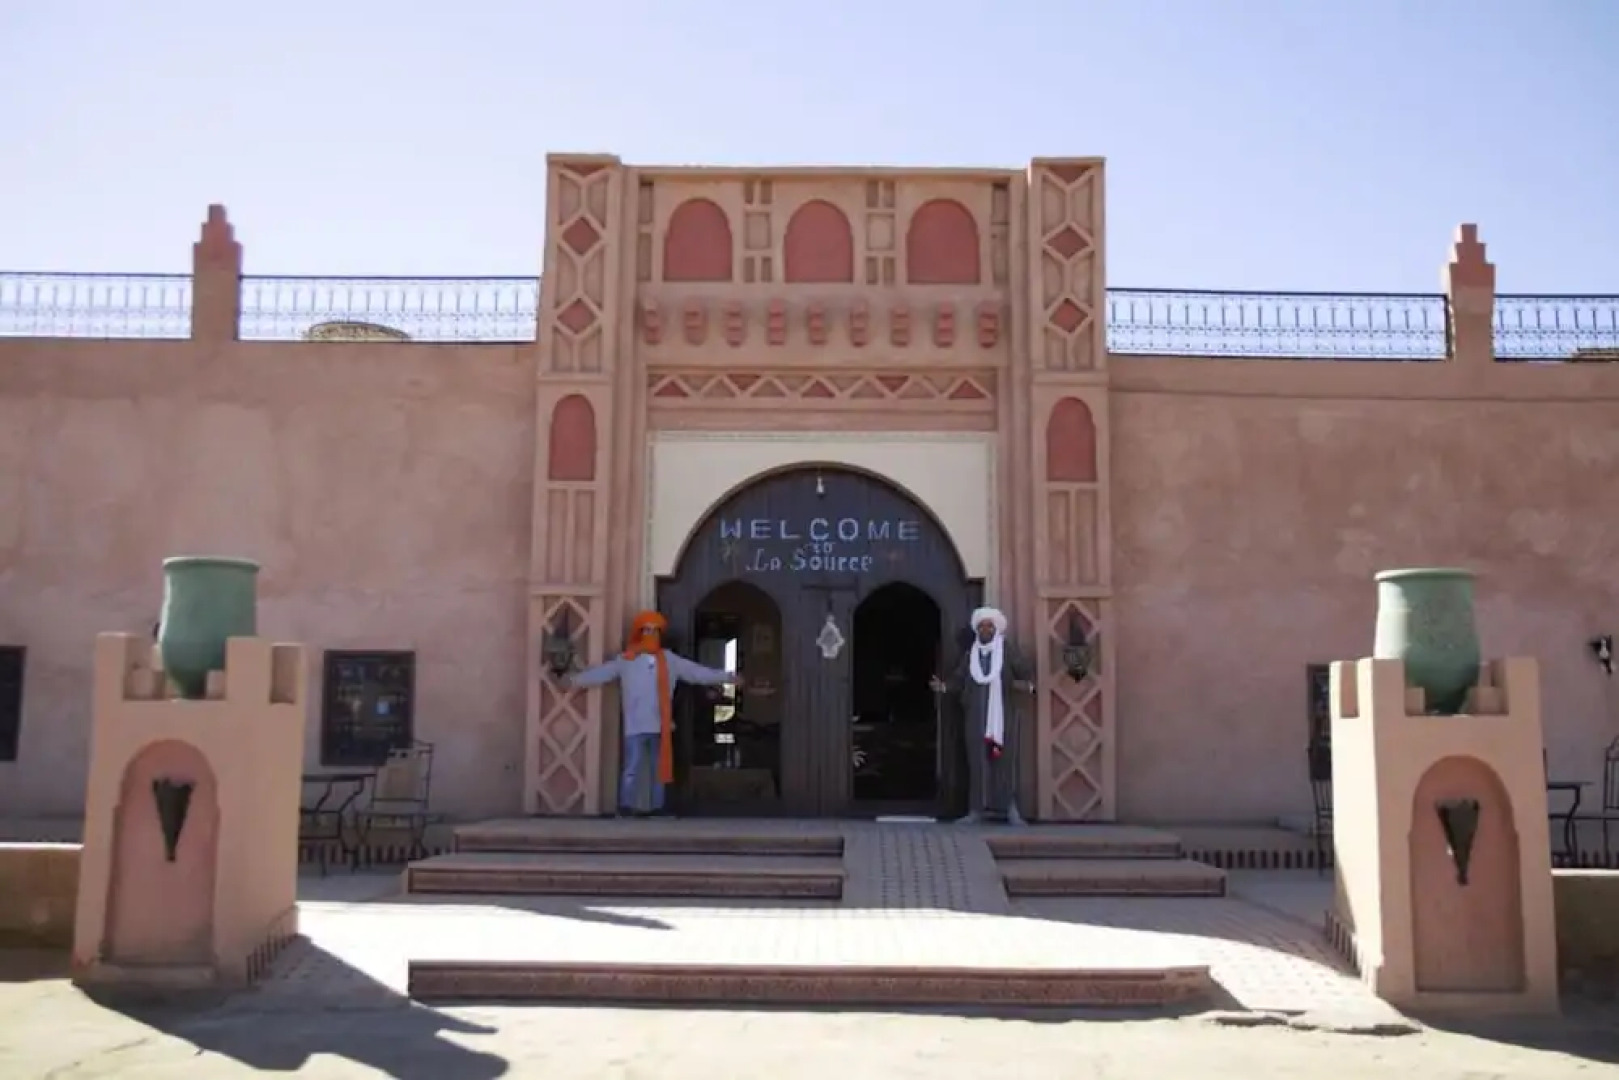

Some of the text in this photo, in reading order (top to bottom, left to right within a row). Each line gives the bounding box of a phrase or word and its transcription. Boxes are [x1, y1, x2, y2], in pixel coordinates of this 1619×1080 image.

[720, 517, 921, 540] WELCOME
[746, 548, 873, 571] La Source
